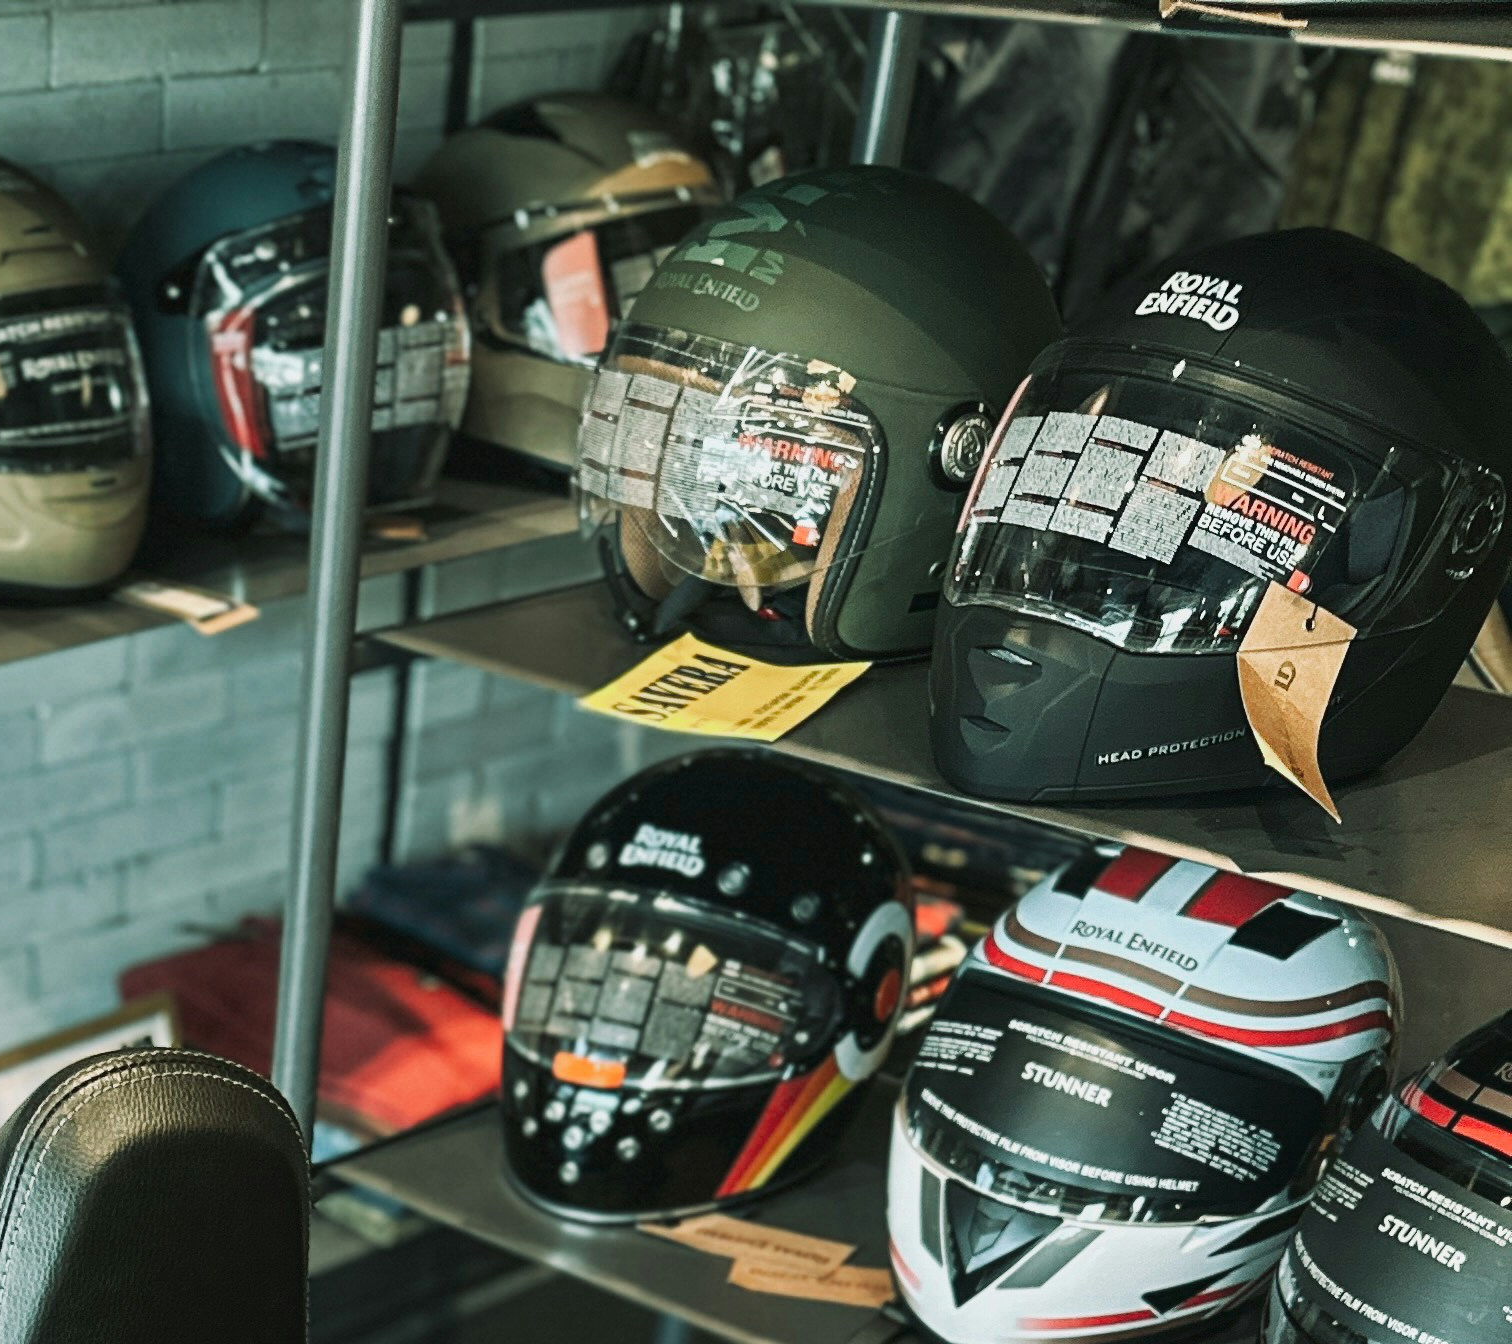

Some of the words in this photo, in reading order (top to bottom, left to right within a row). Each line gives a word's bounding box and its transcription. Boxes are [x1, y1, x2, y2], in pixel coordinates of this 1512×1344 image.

[691, 273, 760, 312] ENFIELD
[1135, 292, 1240, 331] ENFIELD
[1160, 271, 1243, 305] ROYAL
[1204, 502, 1255, 533] REMOVE
[1254, 522, 1281, 545] THIS
[1214, 484, 1317, 545] WARNING
[1197, 513, 1266, 554] BEFORE
[1266, 544, 1299, 571] USE
[611, 654, 751, 722] SAVERA
[1097, 748, 1143, 766] HEAD
[1148, 727, 1247, 757] PROTECTION
[619, 843, 706, 878] ENFIELD
[634, 824, 701, 855] ROYAL
[1070, 920, 1124, 945] ROYAL
[1125, 932, 1199, 972] ENFIELD
[1062, 1035, 1135, 1068] RESISTANT
[1134, 1060, 1176, 1085] VISOR
[1021, 1061, 1113, 1108] STUNNER
[1381, 1167, 1429, 1197] SCRATCH
[1426, 1189, 1496, 1231] RESISTANT
[1378, 1214, 1467, 1272] STUNNER
[1340, 1291, 1363, 1311] FILM
[1359, 1304, 1389, 1325] FROM
[1387, 1317, 1419, 1340] VISOR
